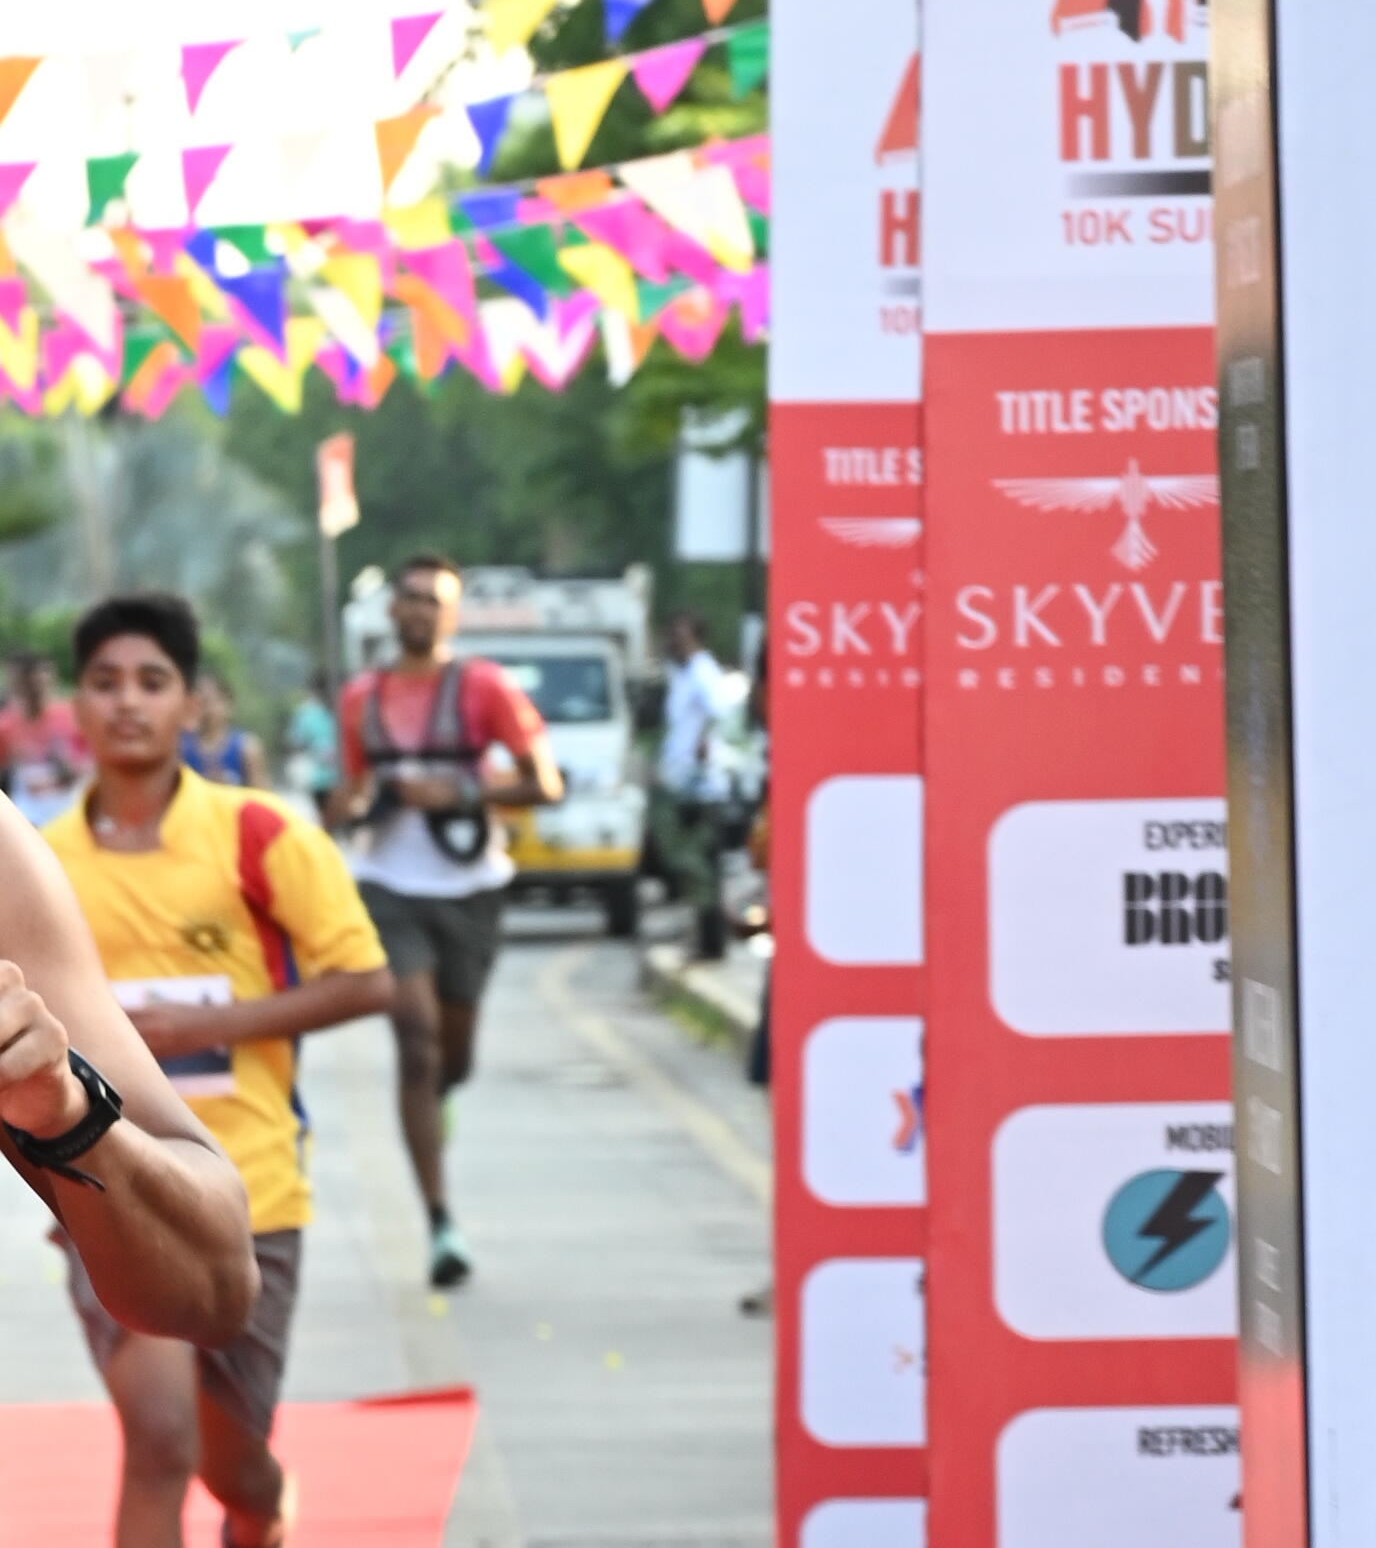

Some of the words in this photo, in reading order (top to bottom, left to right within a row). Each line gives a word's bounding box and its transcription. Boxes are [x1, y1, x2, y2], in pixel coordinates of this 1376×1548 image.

[1060, 209, 1134, 245] 10K
[996, 390, 1094, 434] TITLE
[823, 446, 901, 486] TITLE
[957, 663, 1226, 692] RESIDEN
